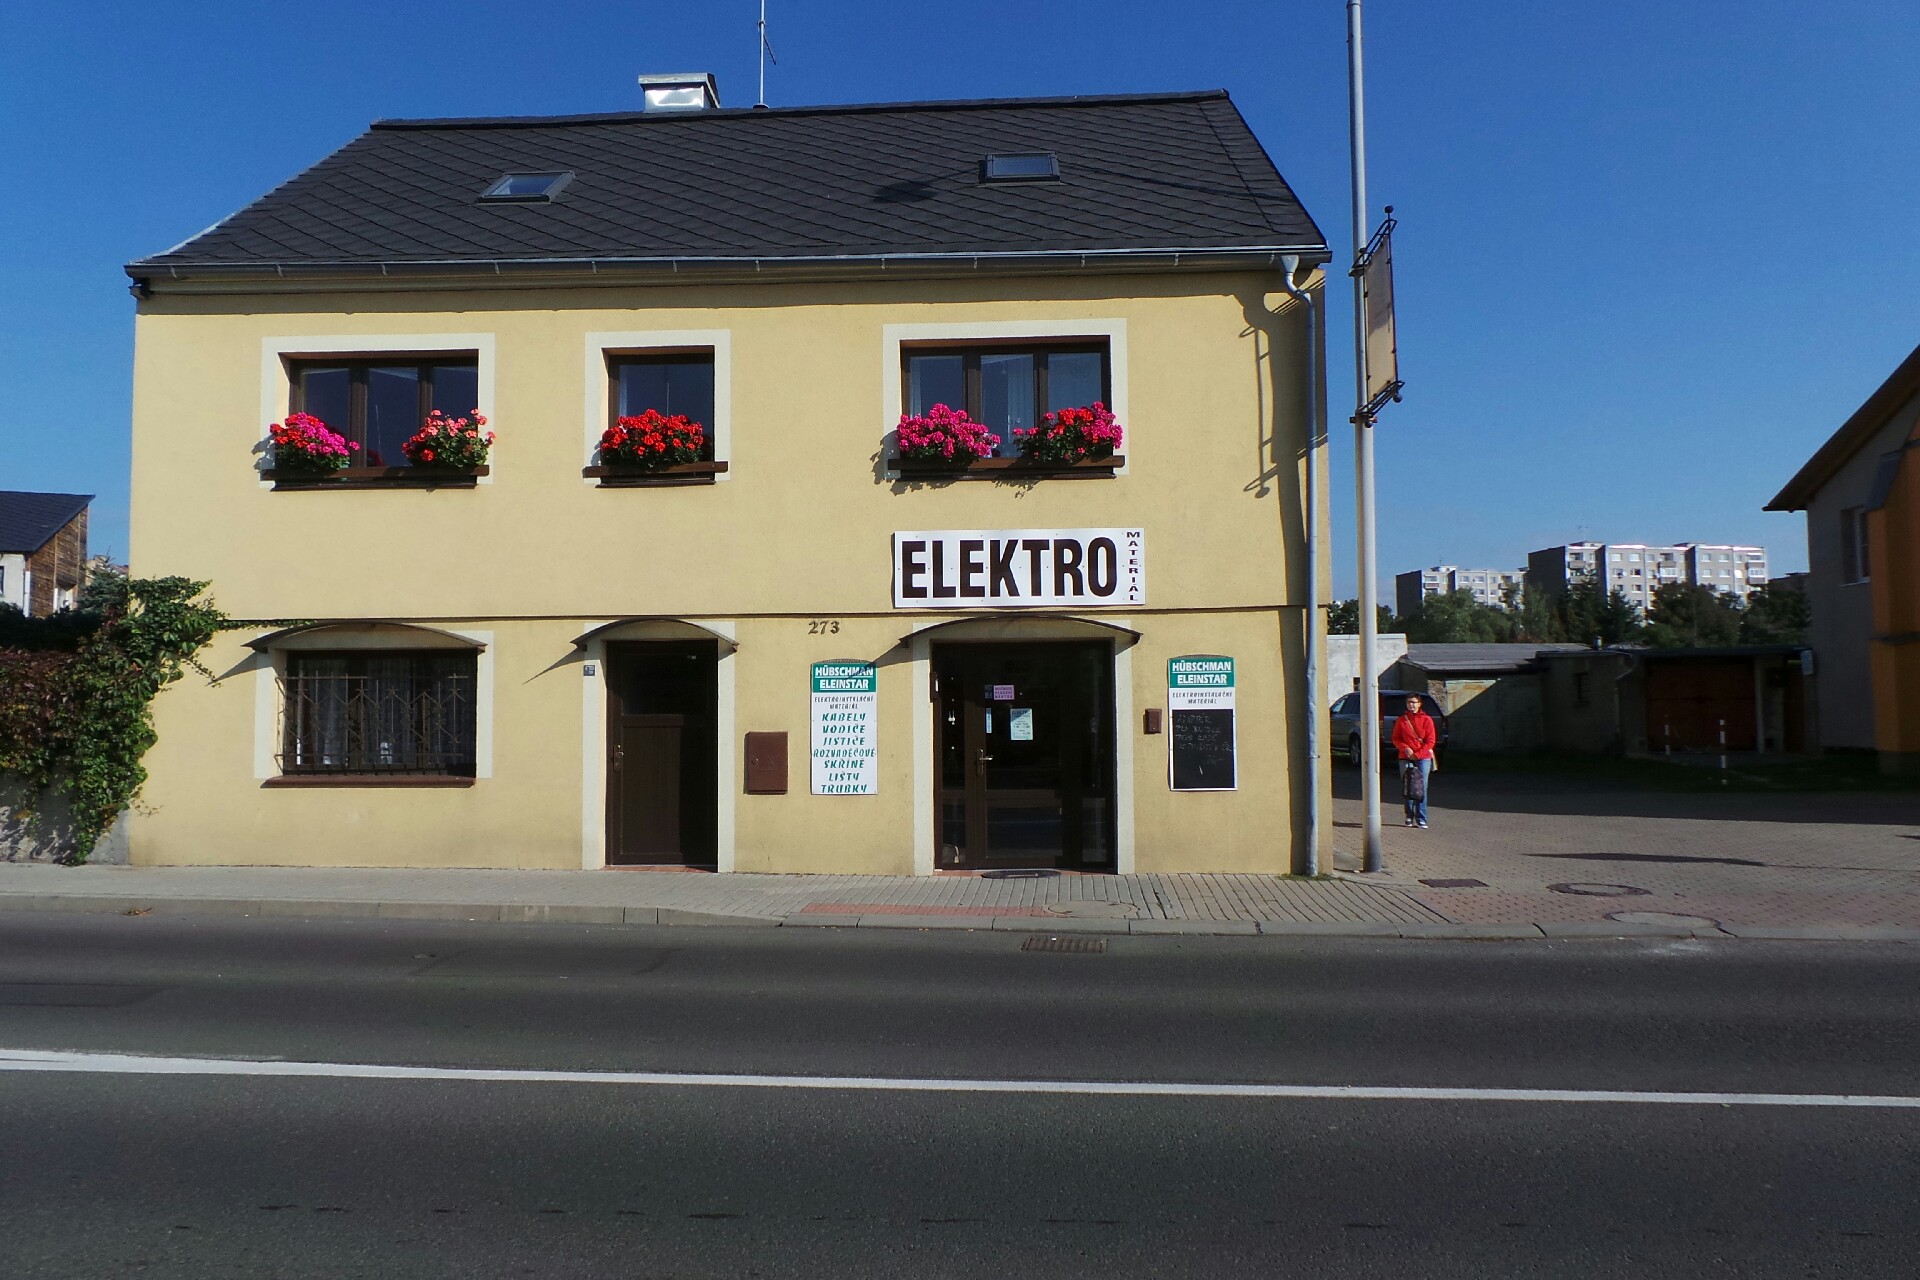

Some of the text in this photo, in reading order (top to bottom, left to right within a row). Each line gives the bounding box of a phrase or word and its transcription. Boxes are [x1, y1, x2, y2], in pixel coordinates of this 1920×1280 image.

[902, 537, 1117, 598] ELEKTRO
[1126, 531, 1140, 601] MATERIÁL
[808, 620, 840, 635] 273
[815, 665, 874, 676] HÜBSCHMAN
[1172, 660, 1231, 672] HÜBSCHMAN
[820, 679, 869, 689] ELEINSTAR
[1177, 674, 1227, 684] ELEINSTAR
[822, 713, 866, 721] KABELY
[823, 723, 865, 733] VODIČE
[823, 735, 865, 746] JISTIČE
[829, 771, 859, 781] LIŠTY
[821, 784, 867, 793] TRUBKY
